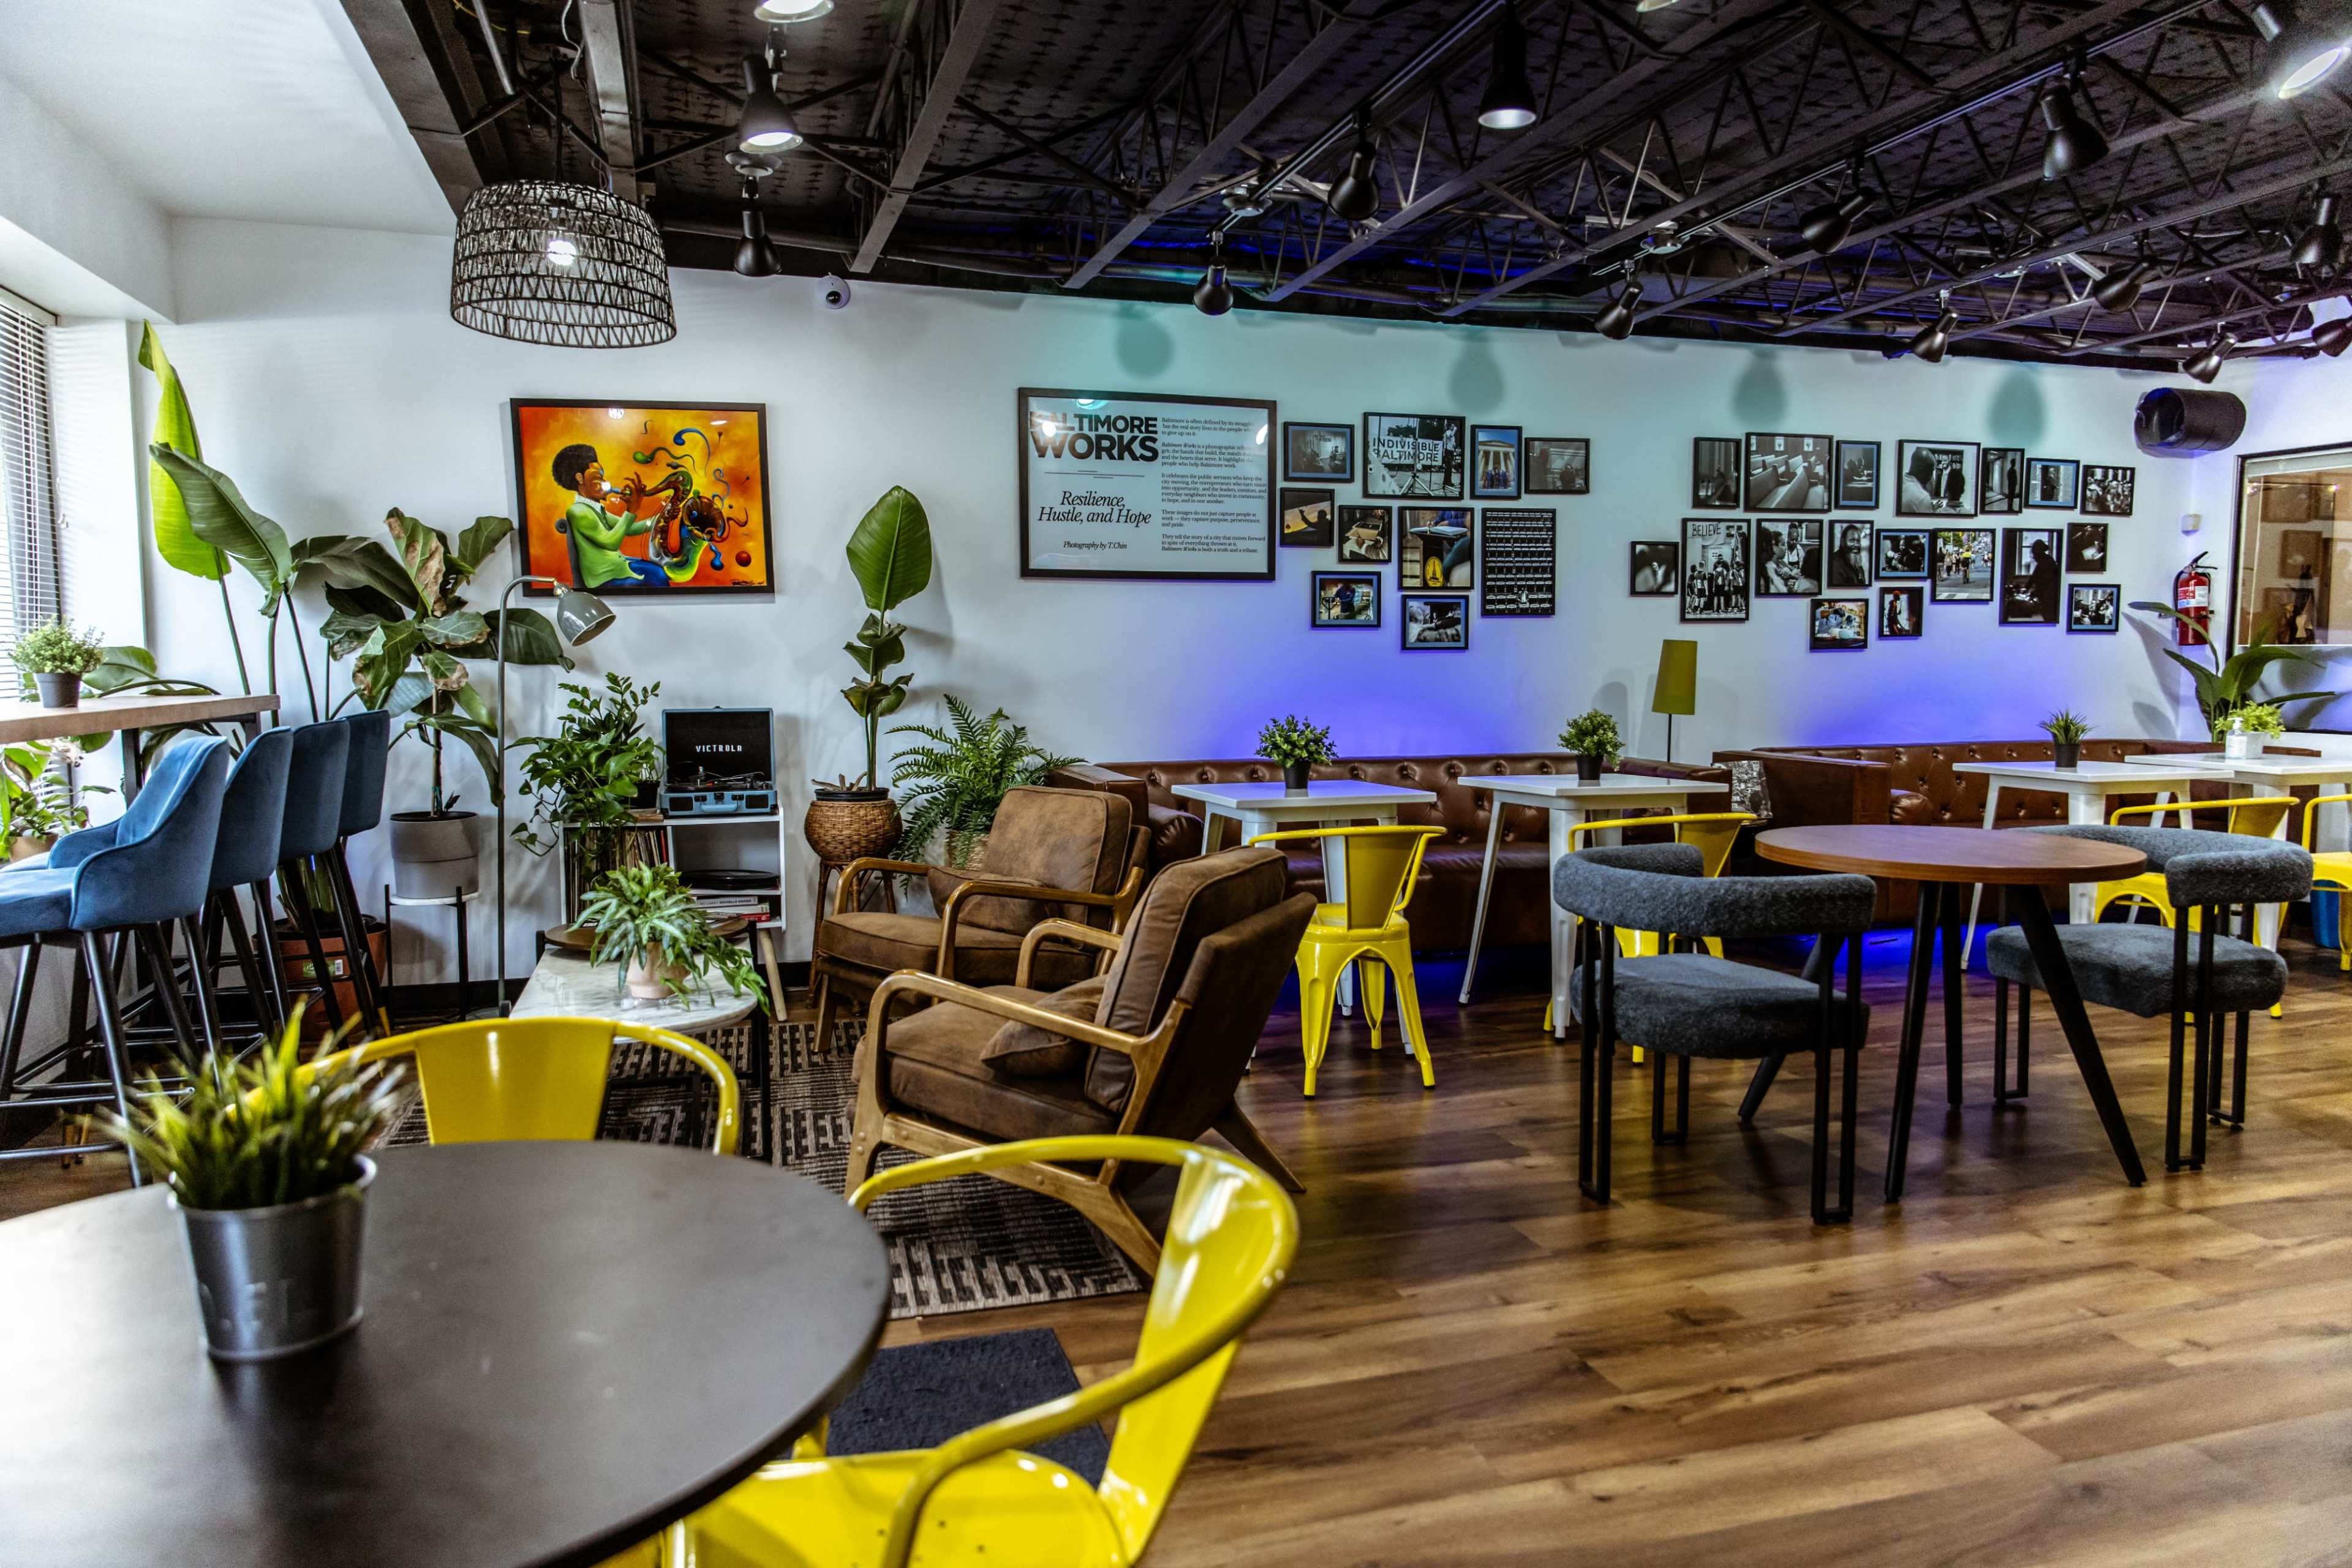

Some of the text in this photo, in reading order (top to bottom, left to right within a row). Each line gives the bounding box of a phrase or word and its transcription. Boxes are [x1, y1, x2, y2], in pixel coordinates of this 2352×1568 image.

[1030, 431, 1159, 462] WORKS
[1373, 437, 1439, 451] INDIVISIBLE
[1060, 491, 1126, 510] Resilience,
[1038, 507, 1152, 528] Hustle, and Hope
[1692, 524, 1721, 537] BELIEVE
[1063, 541, 1099, 550] Photography
